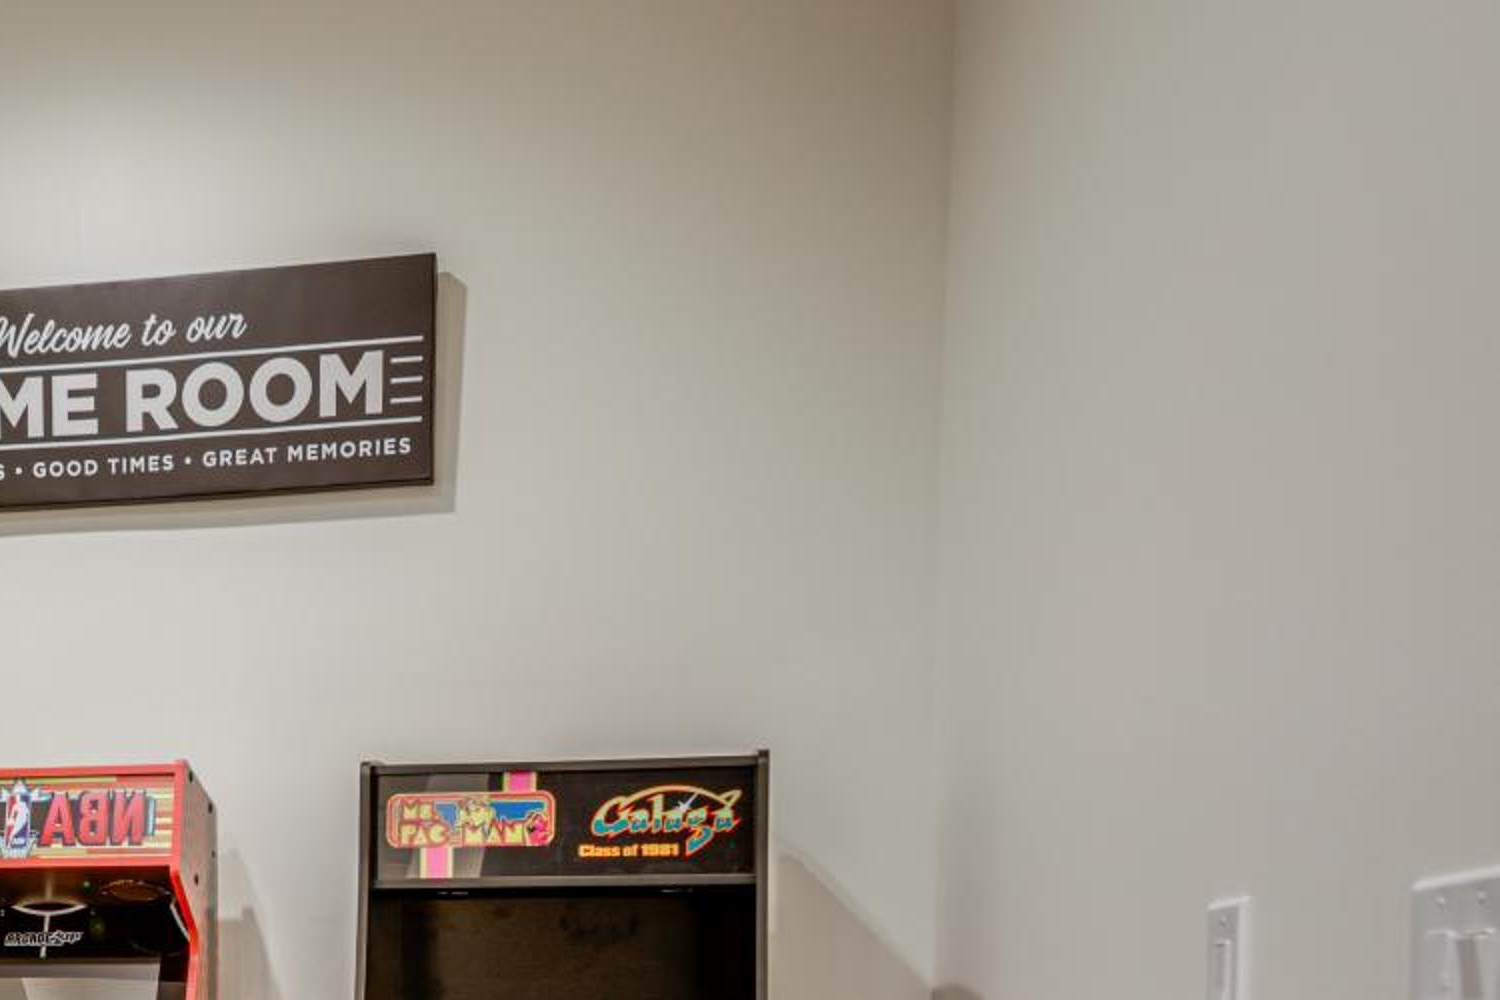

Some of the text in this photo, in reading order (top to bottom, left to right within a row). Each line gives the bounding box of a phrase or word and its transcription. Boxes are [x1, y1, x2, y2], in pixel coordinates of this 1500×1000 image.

[141, 312, 175, 347] to
[185, 310, 248, 343] our
[126, 350, 384, 432] ROOM
[32, 457, 99, 478] GOOD
[107, 454, 175, 475] TIMES
[202, 445, 278, 468] GREAT
[287, 436, 412, 464] MEMORIES
[579, 843, 680, 857] Class of 1981
